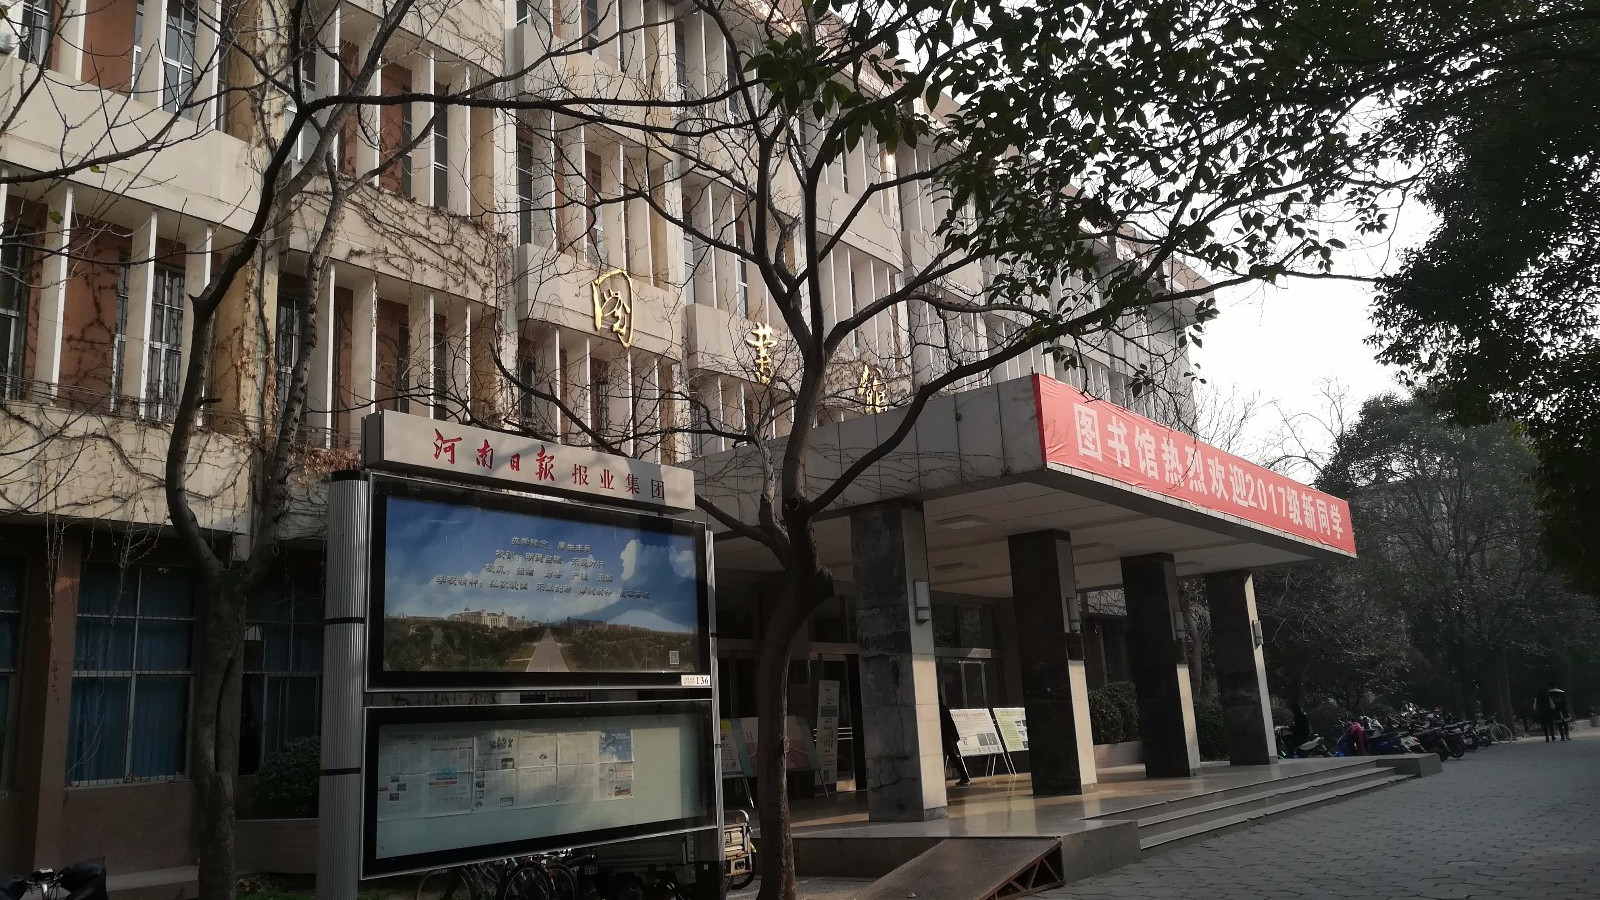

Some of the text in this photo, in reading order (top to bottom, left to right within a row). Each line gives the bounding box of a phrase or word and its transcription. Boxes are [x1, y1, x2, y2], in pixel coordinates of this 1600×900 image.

[1073, 402, 1344, 540] 图书馆热烈欢迎2017级新同学
[696, 676, 709, 685] 136
